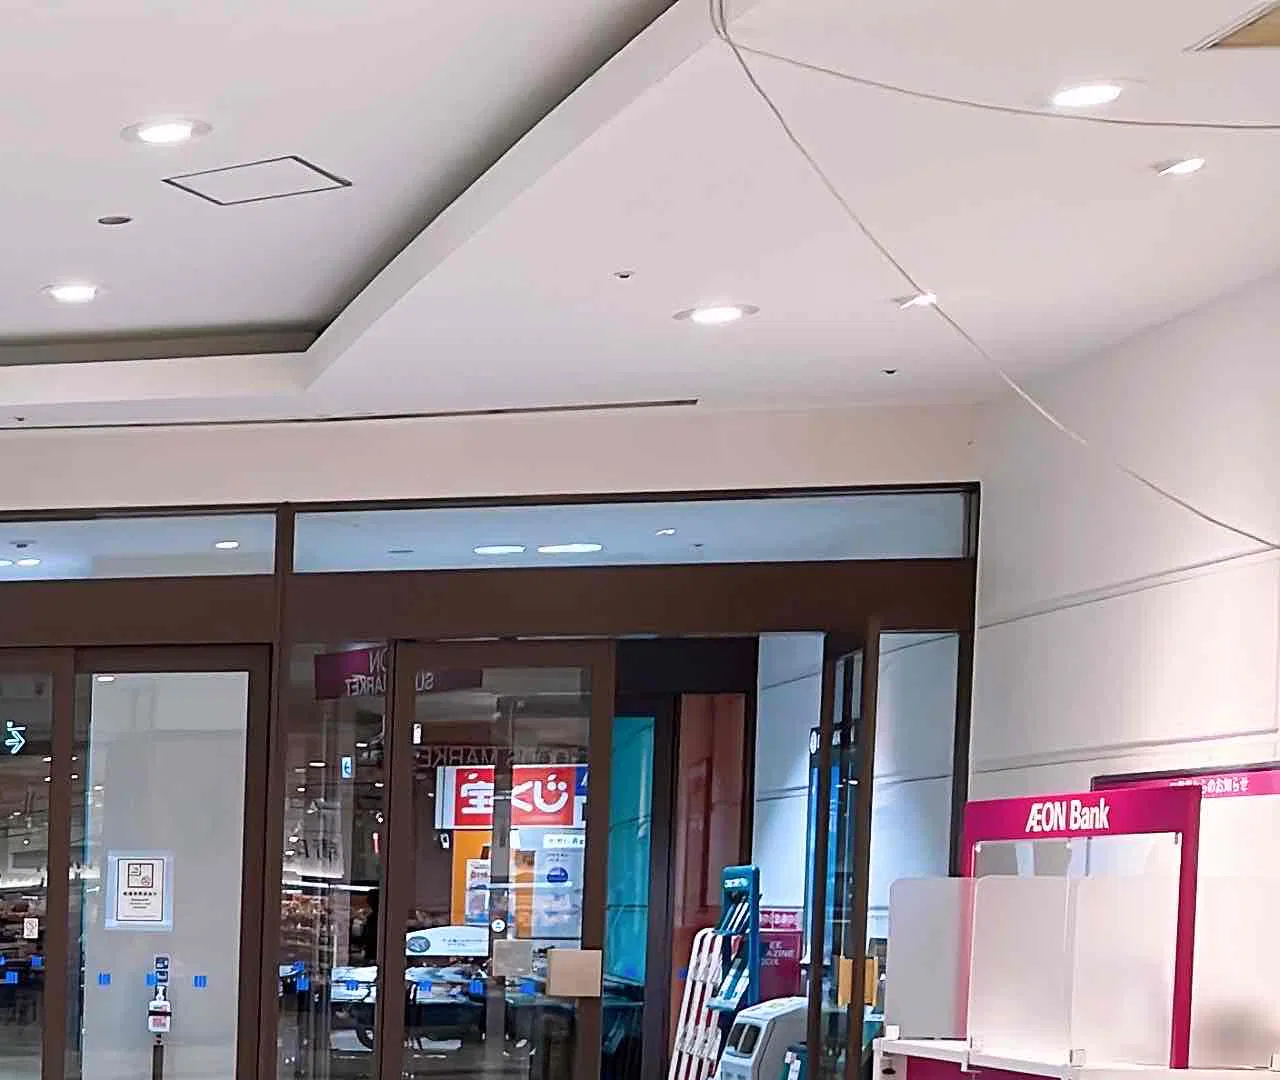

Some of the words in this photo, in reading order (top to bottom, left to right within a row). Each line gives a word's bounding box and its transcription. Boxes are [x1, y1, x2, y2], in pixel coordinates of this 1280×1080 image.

[461, 773, 568, 814] 宝くじ
[1069, 797, 1110, 830] Bank
